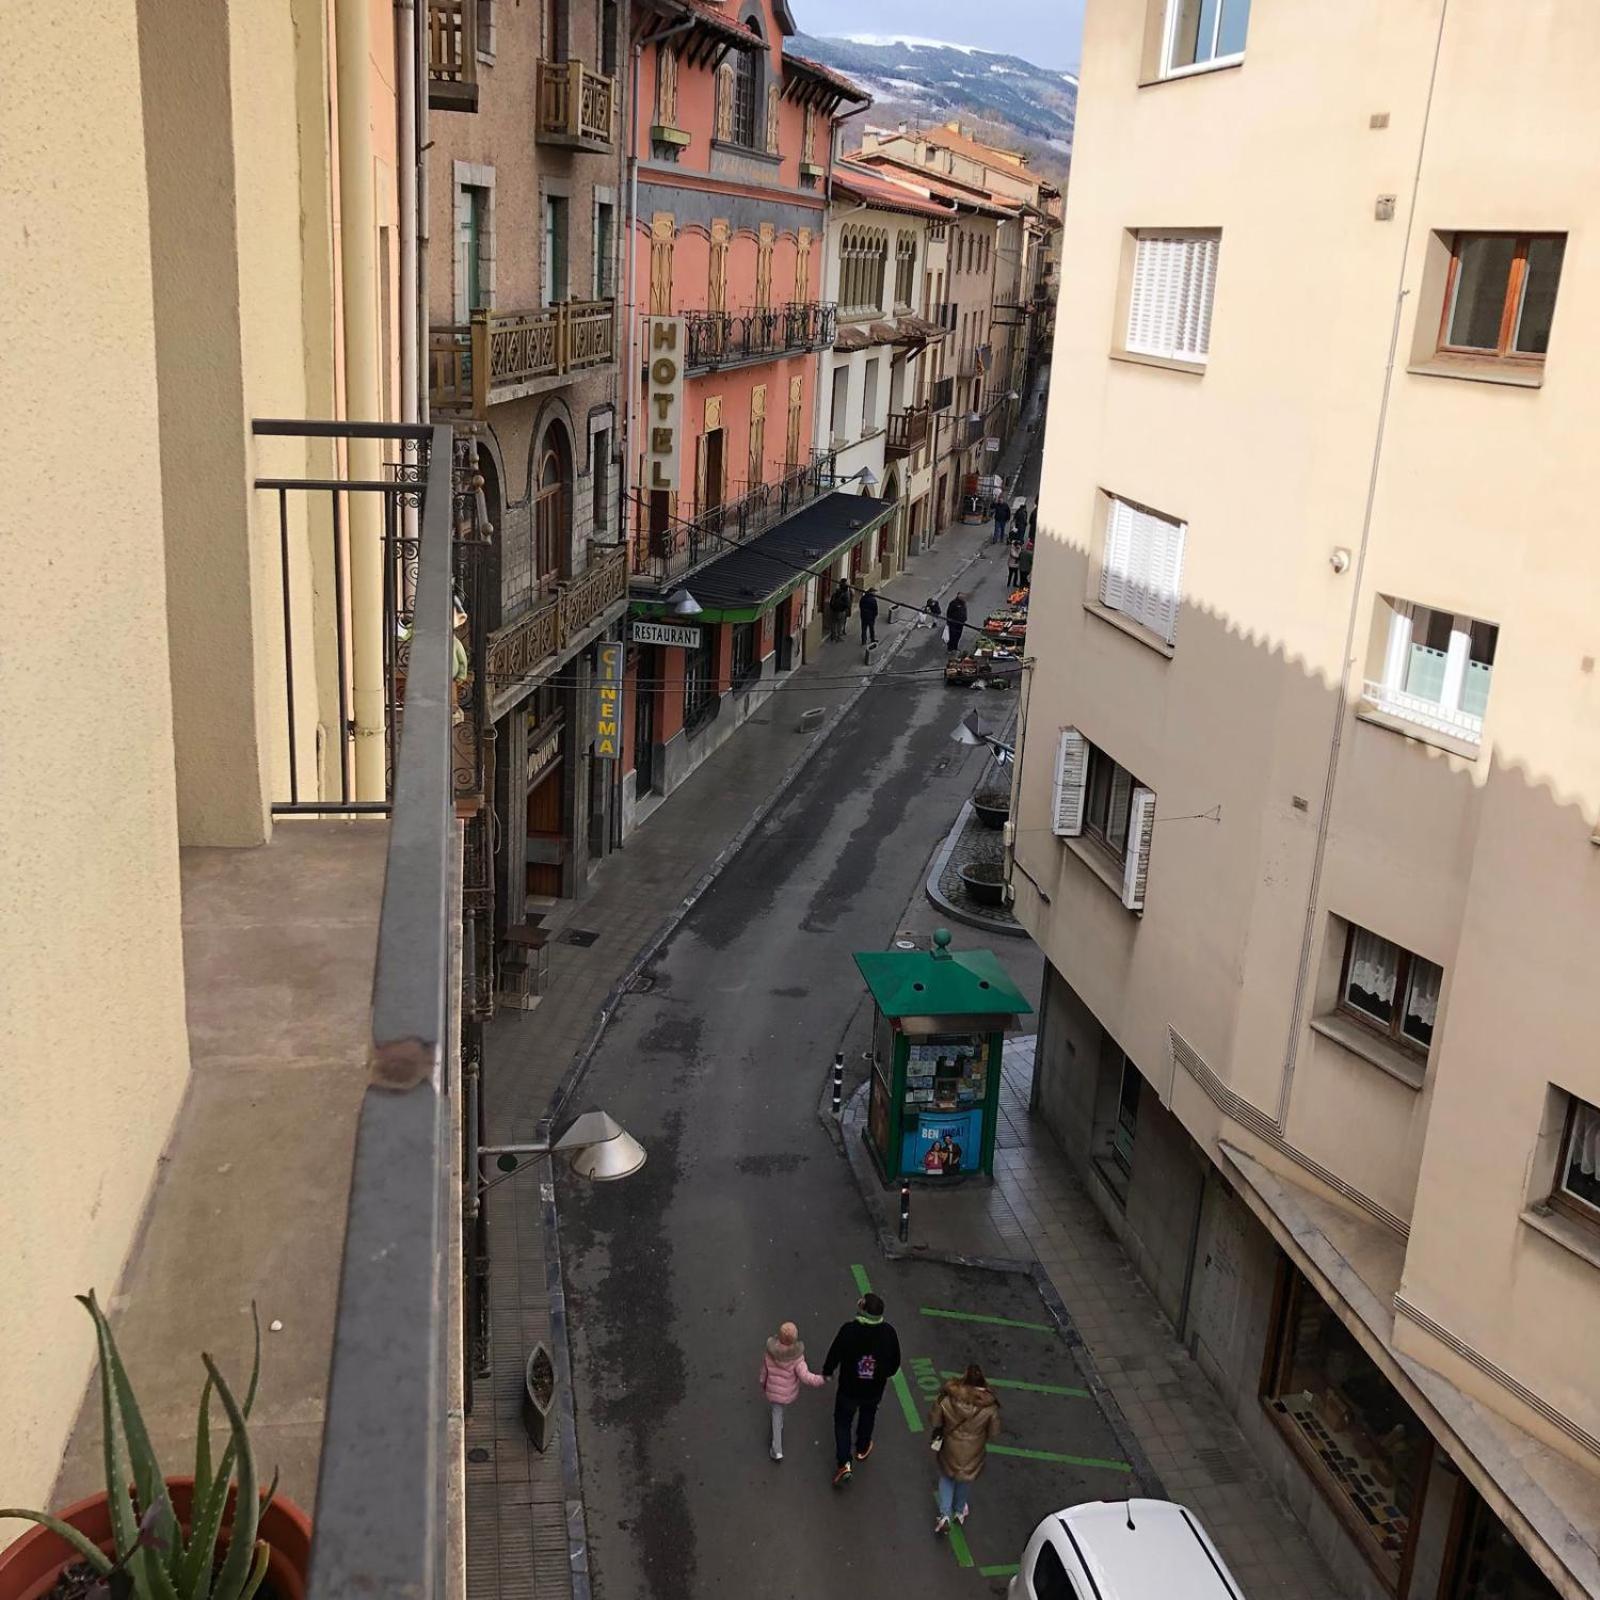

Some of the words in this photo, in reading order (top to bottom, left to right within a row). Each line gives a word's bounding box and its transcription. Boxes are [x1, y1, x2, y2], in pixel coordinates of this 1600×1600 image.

[652, 322, 677, 488] HOTEL
[635, 624, 698, 645] RESTAURANT
[598, 649, 617, 754] CINEMA
